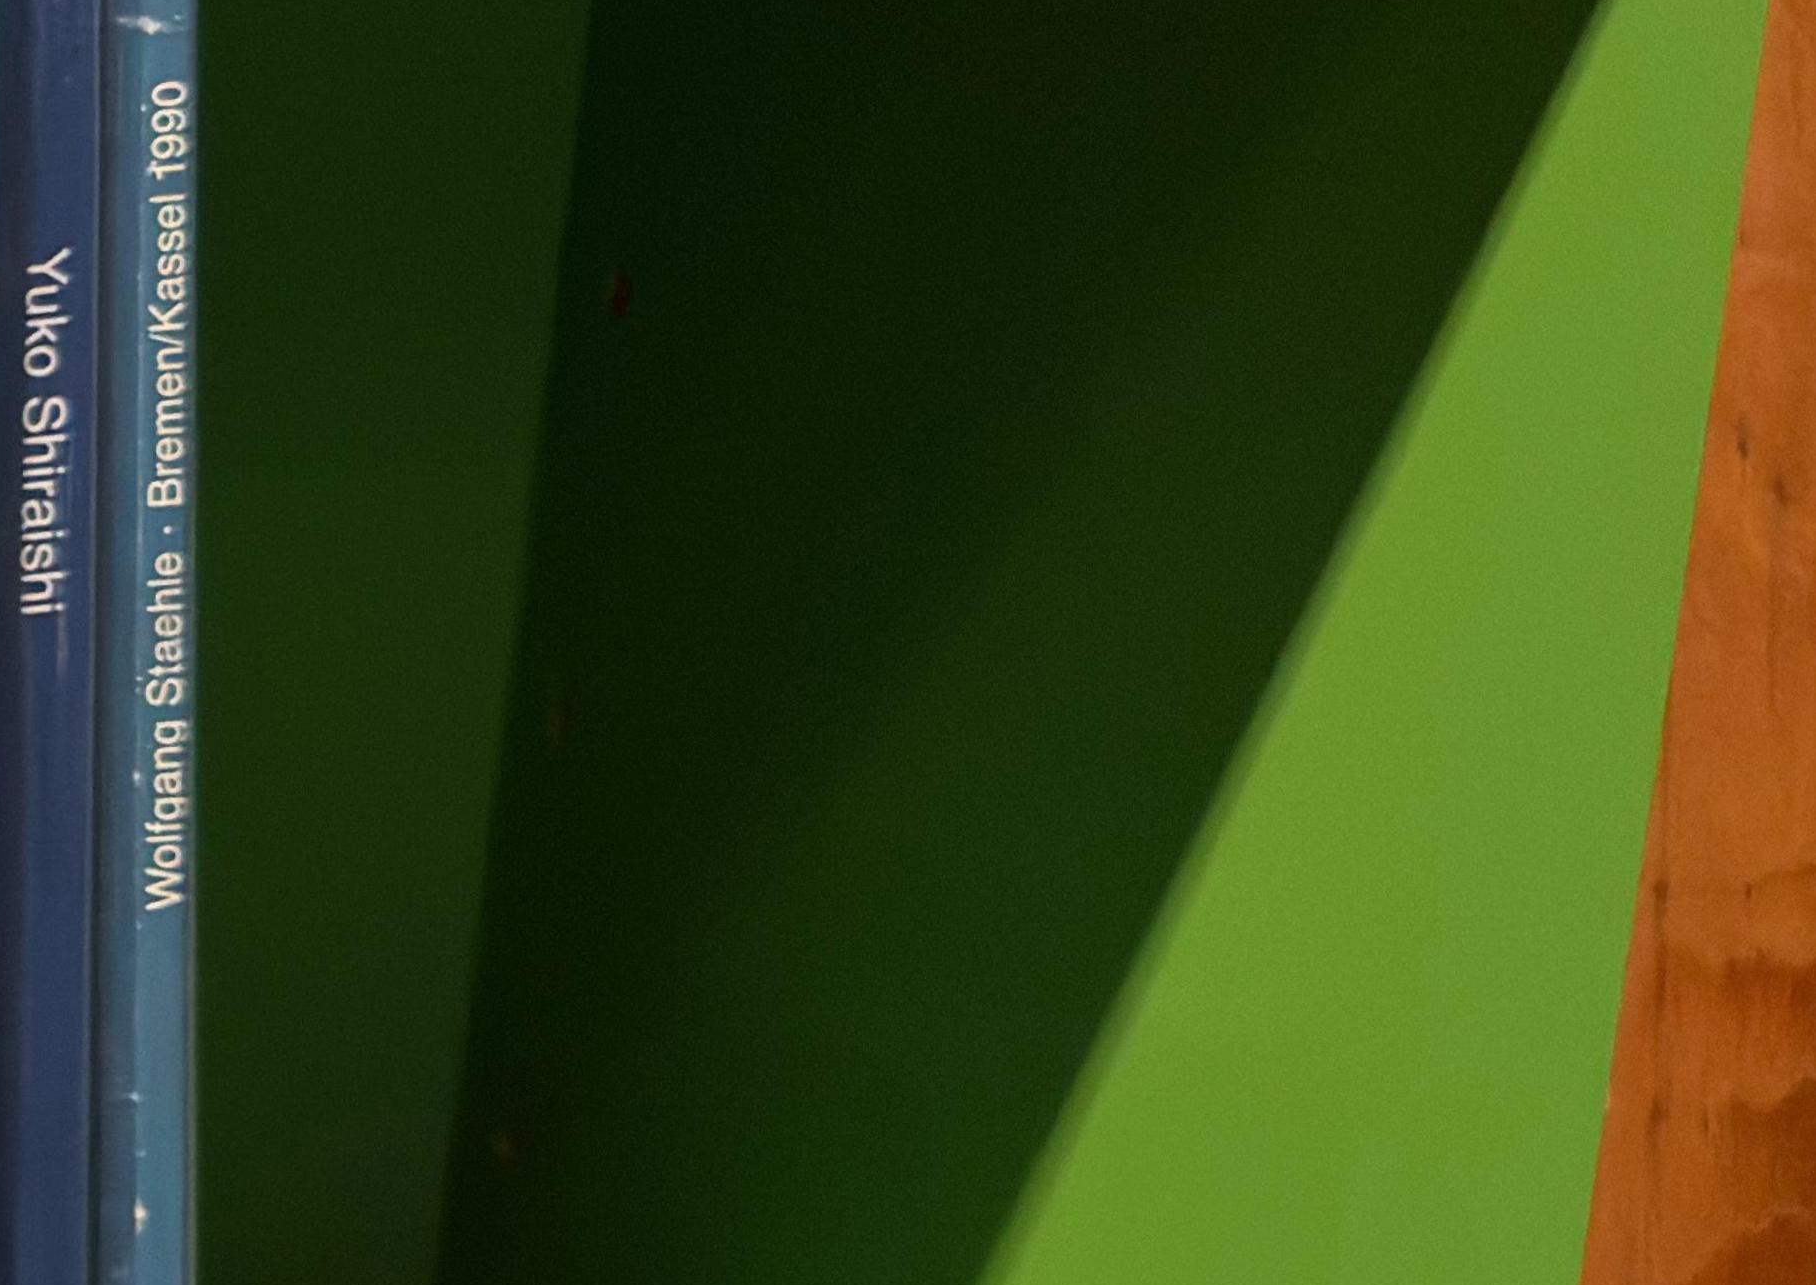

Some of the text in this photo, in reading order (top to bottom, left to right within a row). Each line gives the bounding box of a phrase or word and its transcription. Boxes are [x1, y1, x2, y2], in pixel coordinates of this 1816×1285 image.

[19, 248, 70, 615] Yuko Shiraishi
[143, 82, 187, 910] Wolfgang Staehle 1990
